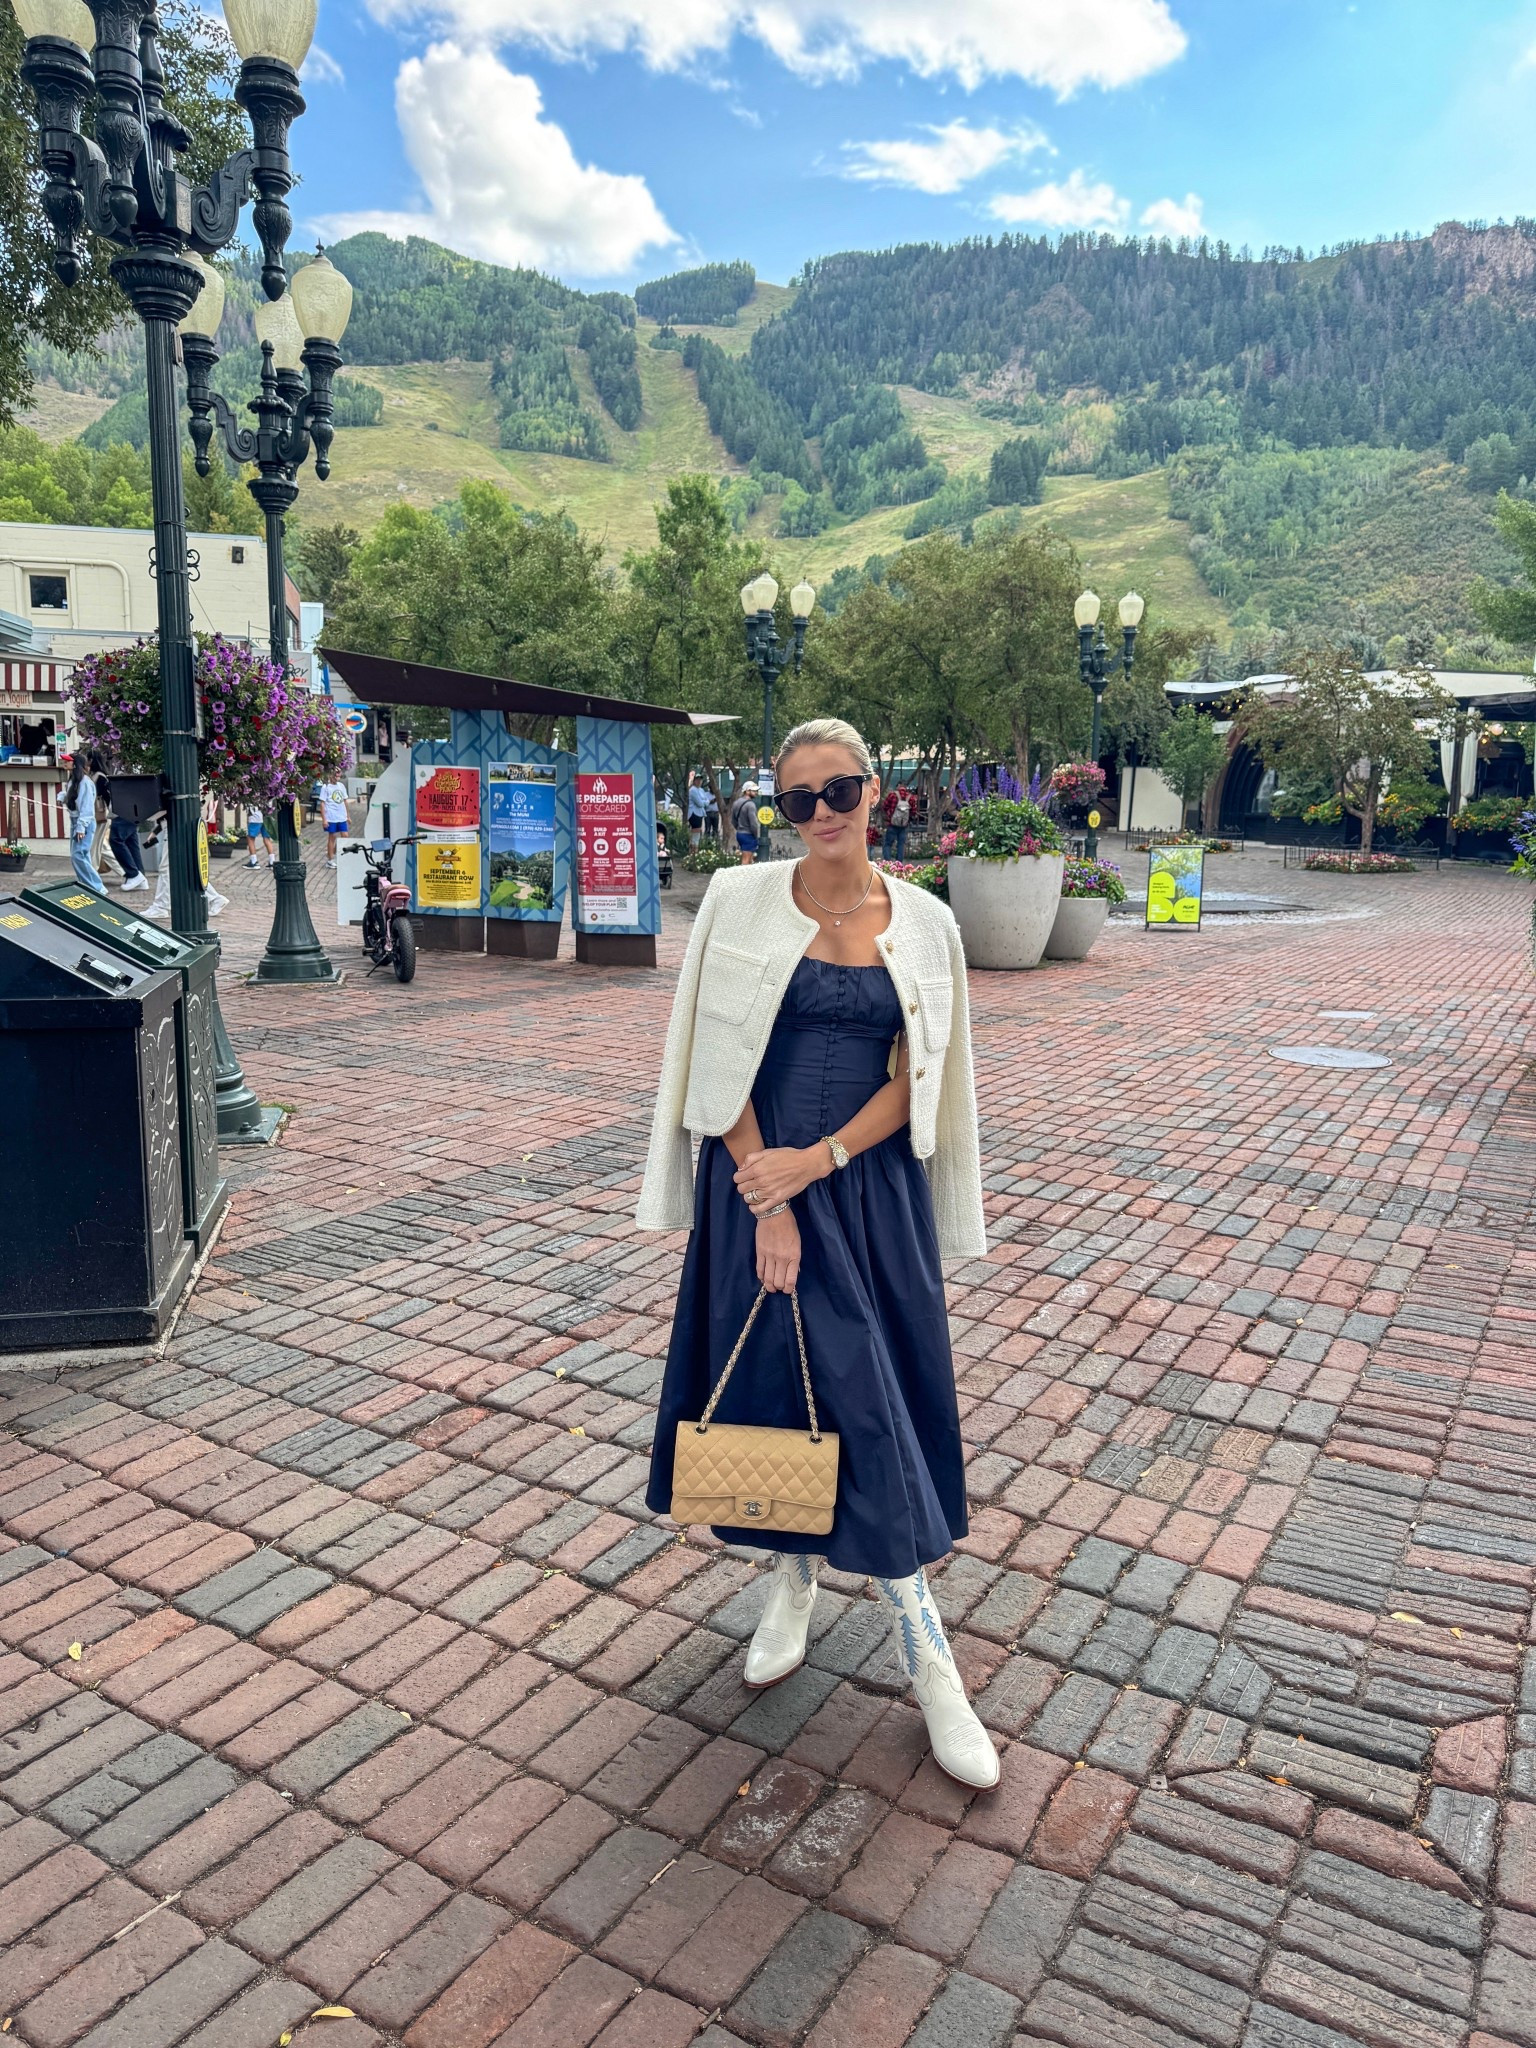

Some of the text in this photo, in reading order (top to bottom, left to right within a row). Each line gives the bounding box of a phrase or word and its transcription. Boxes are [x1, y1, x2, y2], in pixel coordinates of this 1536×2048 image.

[8, 689, 31, 707] Yogurt
[432, 794, 469, 806] AUGUST 17
[583, 794, 631, 803] PREPARED
[593, 804, 627, 813] SCARED
[423, 873, 457, 881] RESTAURANT
